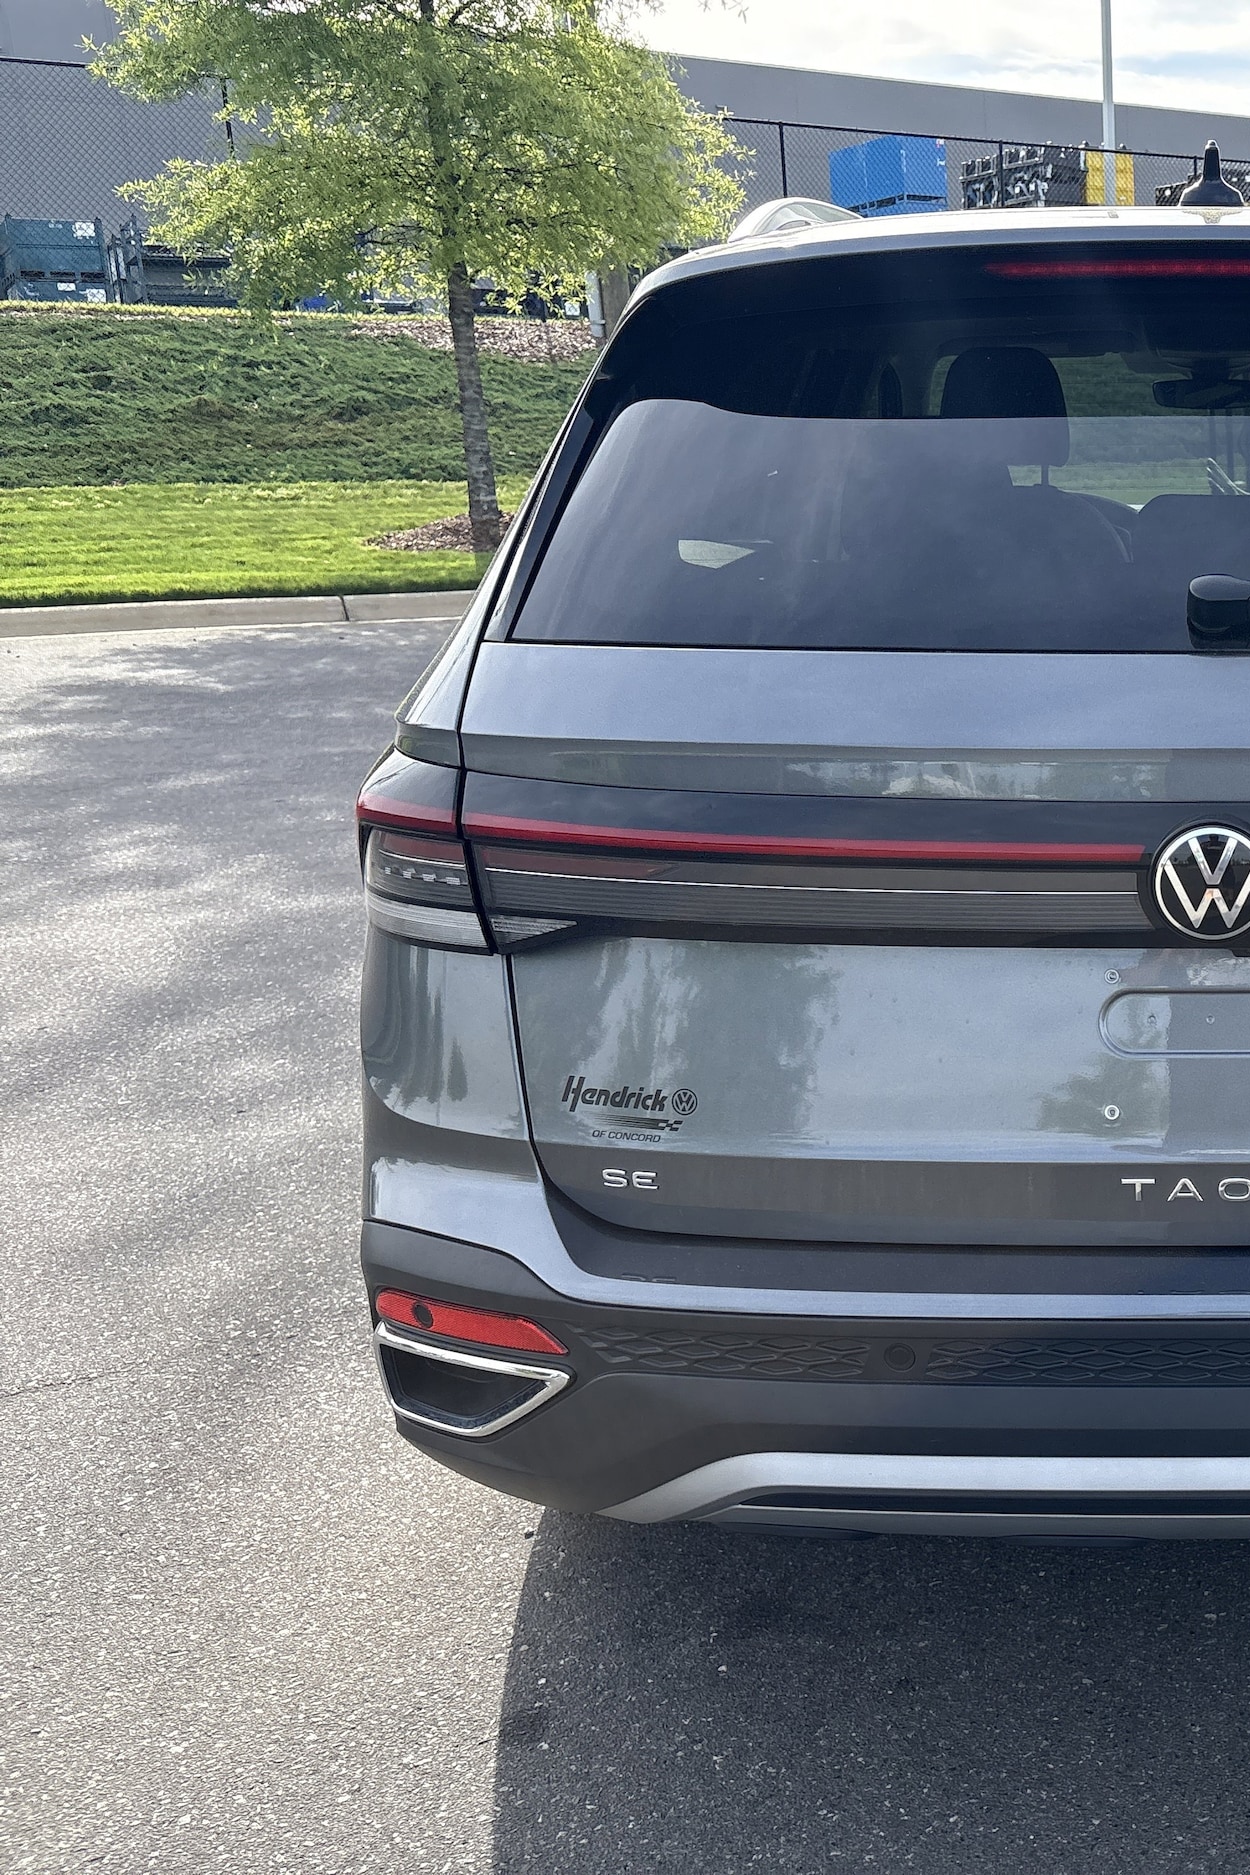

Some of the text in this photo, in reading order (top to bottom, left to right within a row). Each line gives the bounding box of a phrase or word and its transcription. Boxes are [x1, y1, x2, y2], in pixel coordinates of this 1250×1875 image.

[561, 1075, 668, 1113] Hendrick
[592, 1129, 661, 1143] OF CONCORD
[602, 1168, 659, 1190] SE
